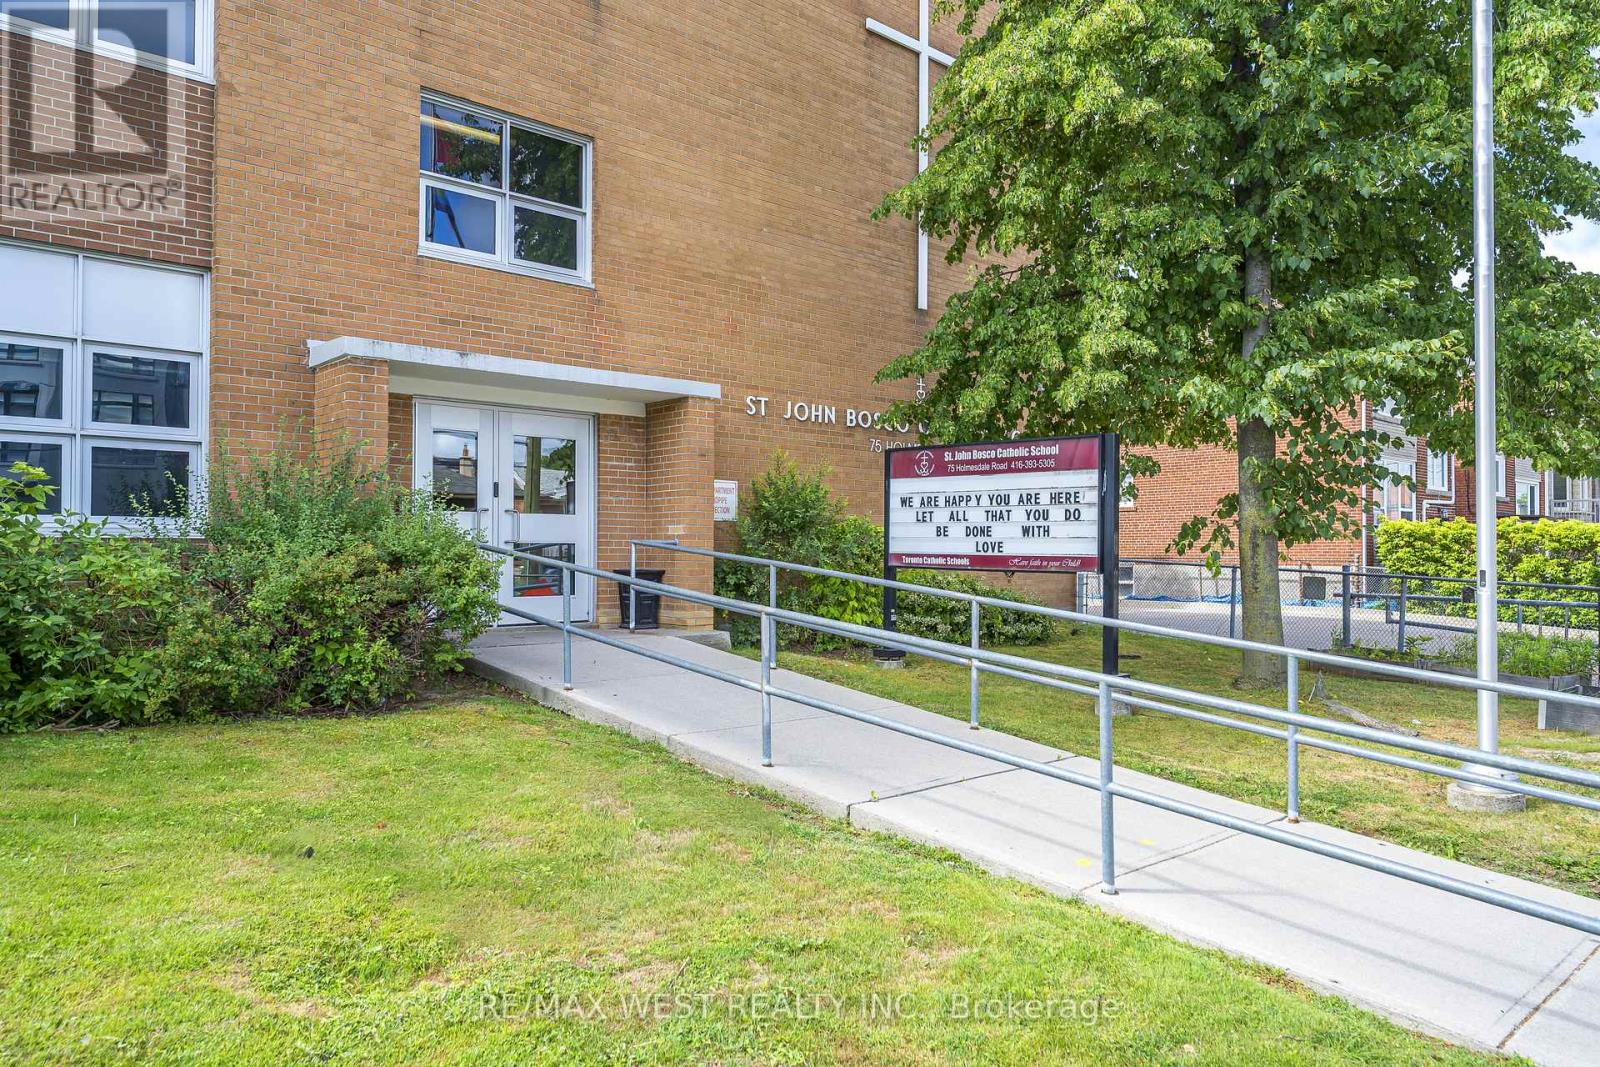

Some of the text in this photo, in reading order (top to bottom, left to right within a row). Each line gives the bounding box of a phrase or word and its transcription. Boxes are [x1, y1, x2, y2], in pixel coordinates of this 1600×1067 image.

[746, 395, 769, 416] ST
[783, 401, 836, 424] JOHN
[869, 438, 882, 453] 75
[944, 444, 1059, 462] St. John Bosco Catholic School
[947, 458, 1056, 473] 75 Holmesdale Road 416-393-5305
[900, 491, 1081, 508] WE ARE HAPPY YOU ARE HERE
[915, 508, 1081, 523] LET ALL THAT YOU DO
[936, 525, 1050, 538] BE DONE WITH
[975, 541, 1004, 554] LOVE
[902, 555, 970, 566] Toronto Catholic Schools
[1008, 557, 1029, 566] Have
[1028, 558, 1042, 568] faith
[1047, 560, 1061, 568] your
